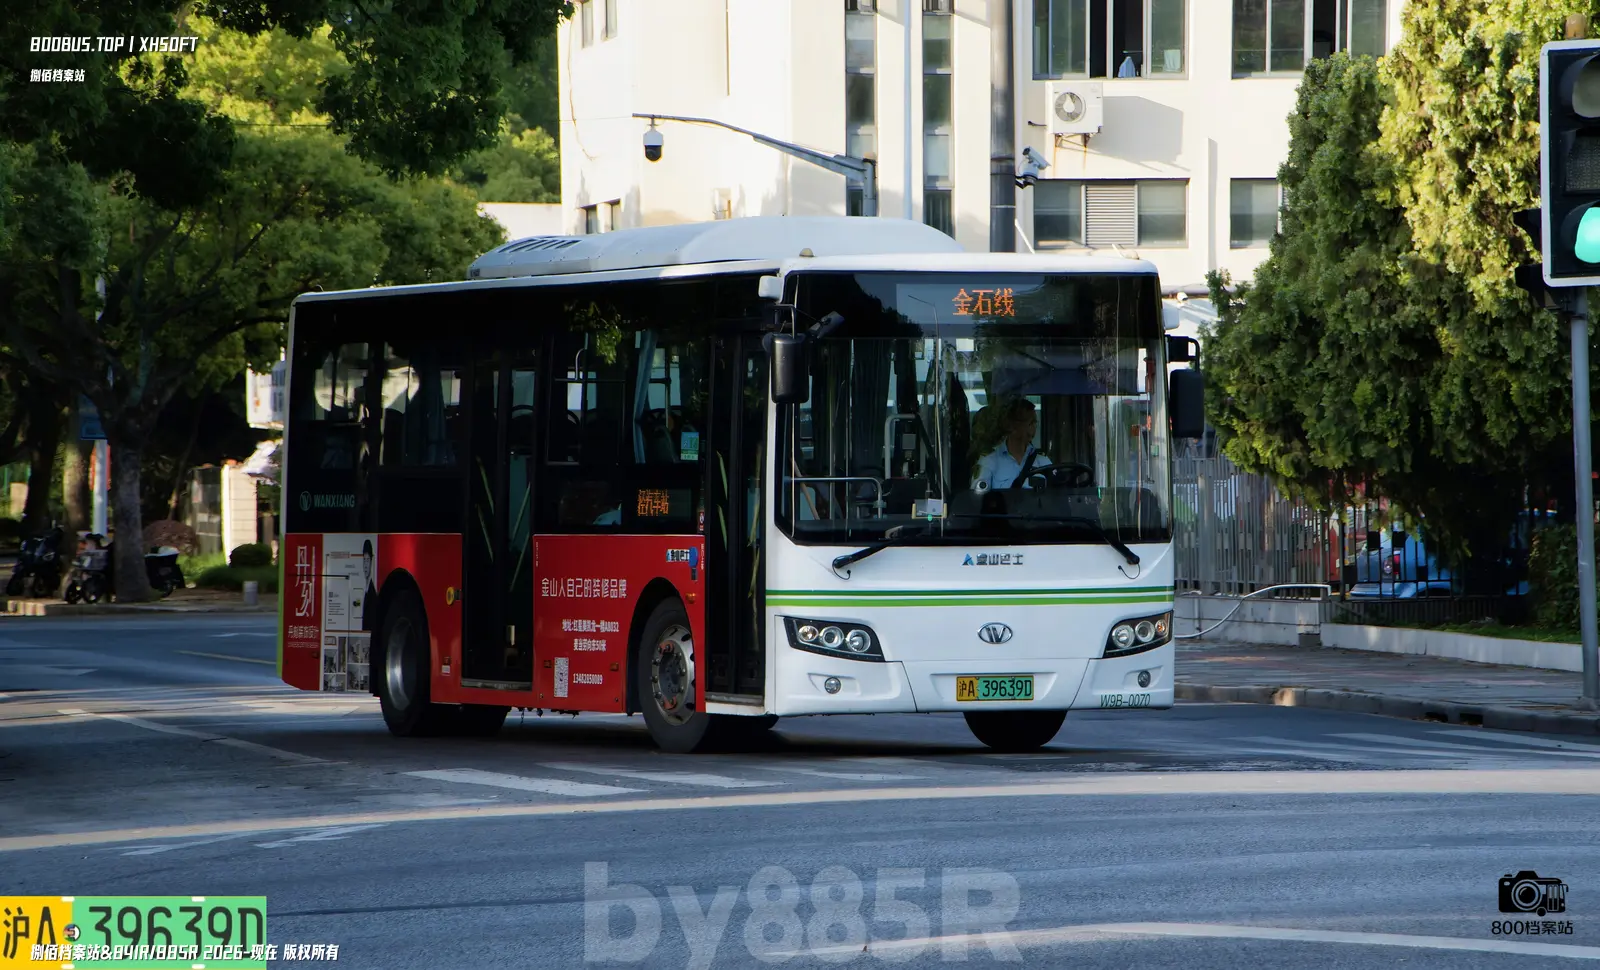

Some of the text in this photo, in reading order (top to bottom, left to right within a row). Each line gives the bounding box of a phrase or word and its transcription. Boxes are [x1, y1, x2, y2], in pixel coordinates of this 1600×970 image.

[951, 287, 1015, 317] 金石线
[313, 493, 355, 508] WANXIANG
[976, 553, 1024, 566] 金山巴士
[541, 577, 628, 599] 金山人自己的装修品牌
[959, 679, 1032, 698] 沪A 39639D
[1100, 694, 1150, 708] W9B-0070
